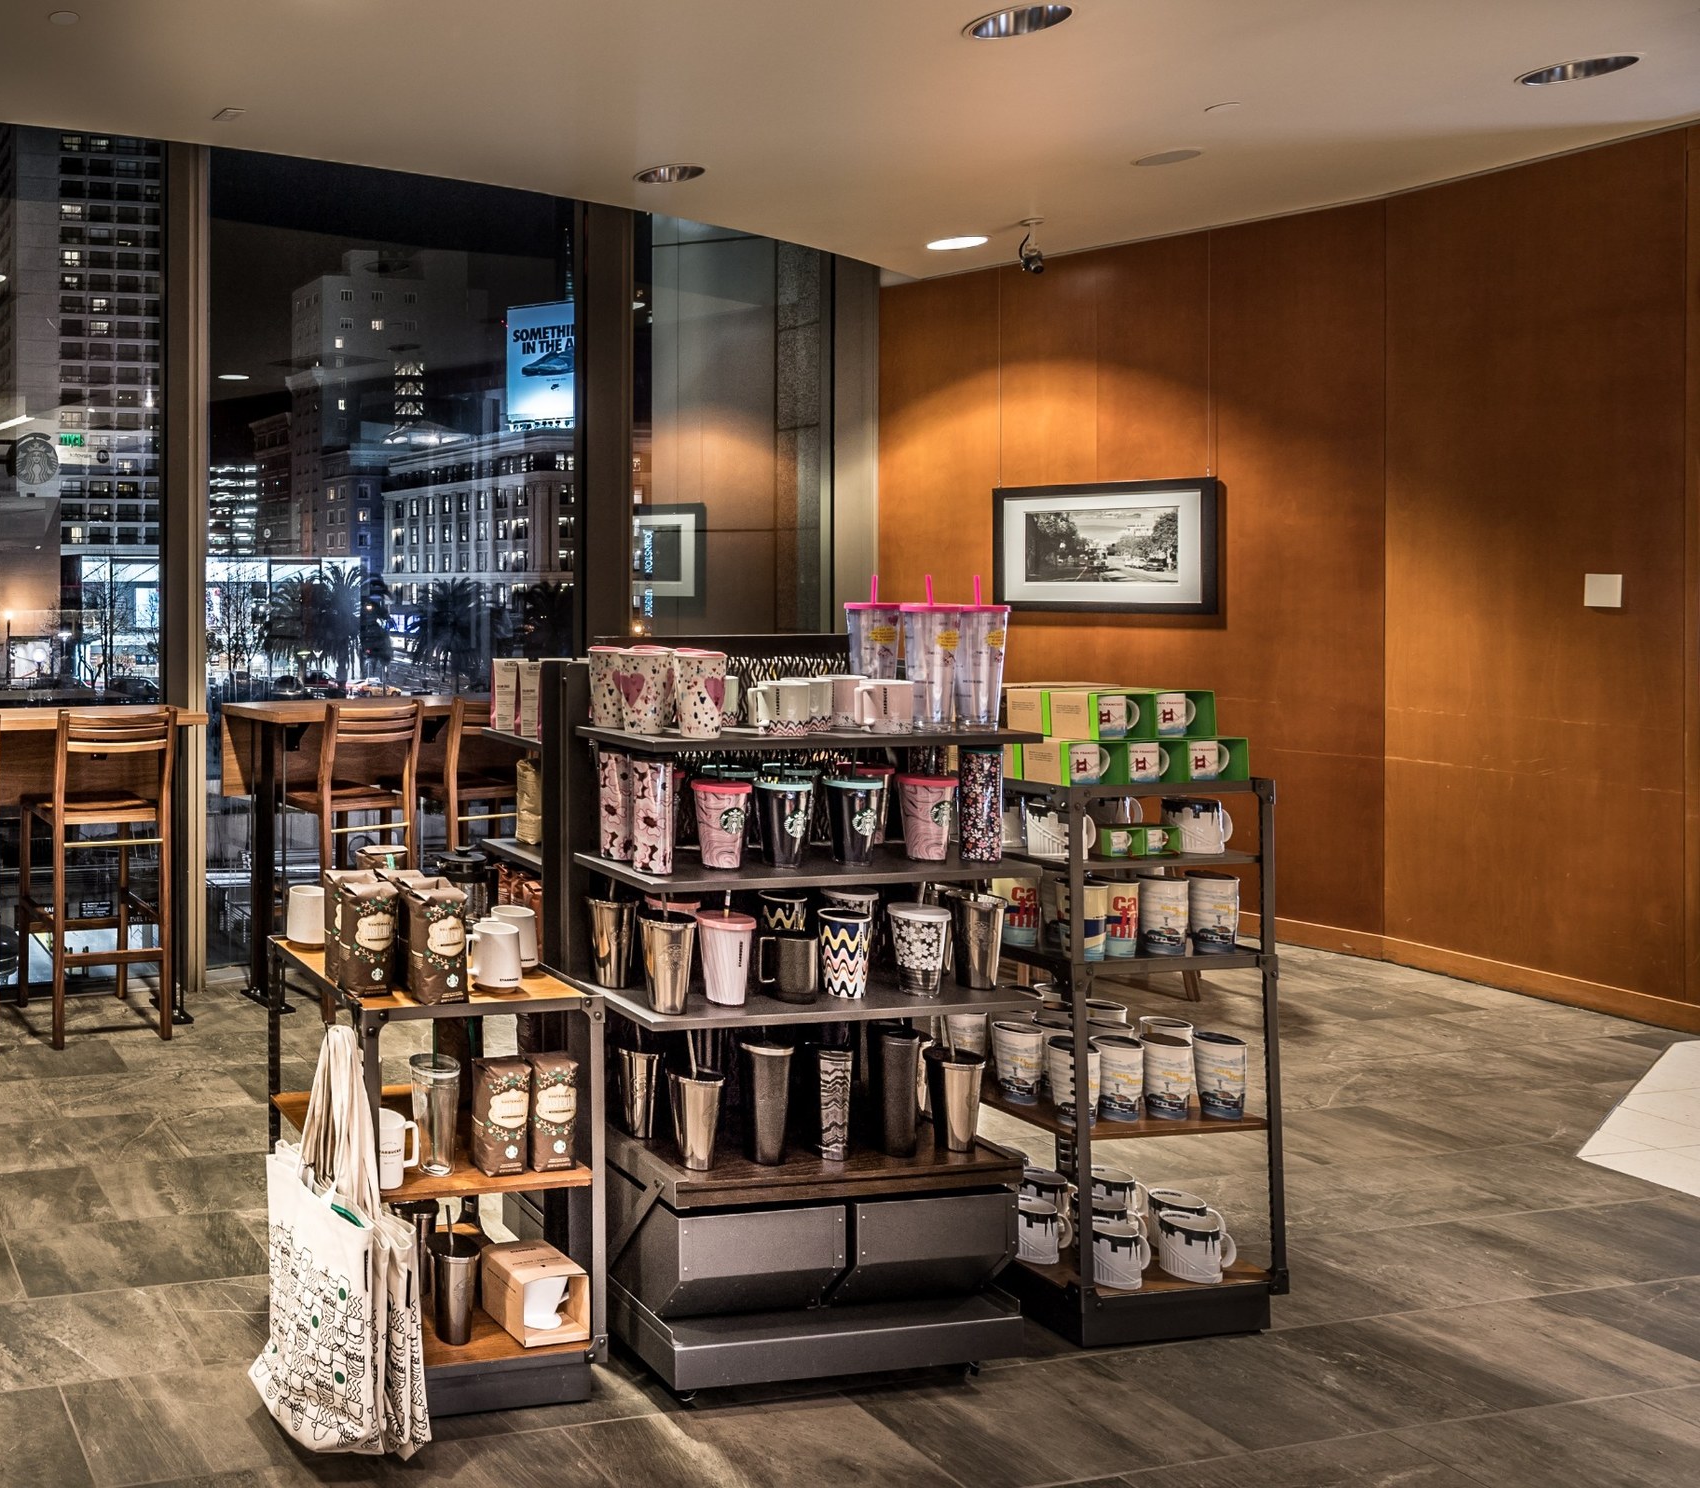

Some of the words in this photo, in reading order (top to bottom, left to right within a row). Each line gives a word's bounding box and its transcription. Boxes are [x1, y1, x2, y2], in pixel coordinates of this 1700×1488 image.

[521, 341, 536, 355] IN
[538, 337, 563, 354] THE
[641, 528, 654, 574] JOHNSTON
